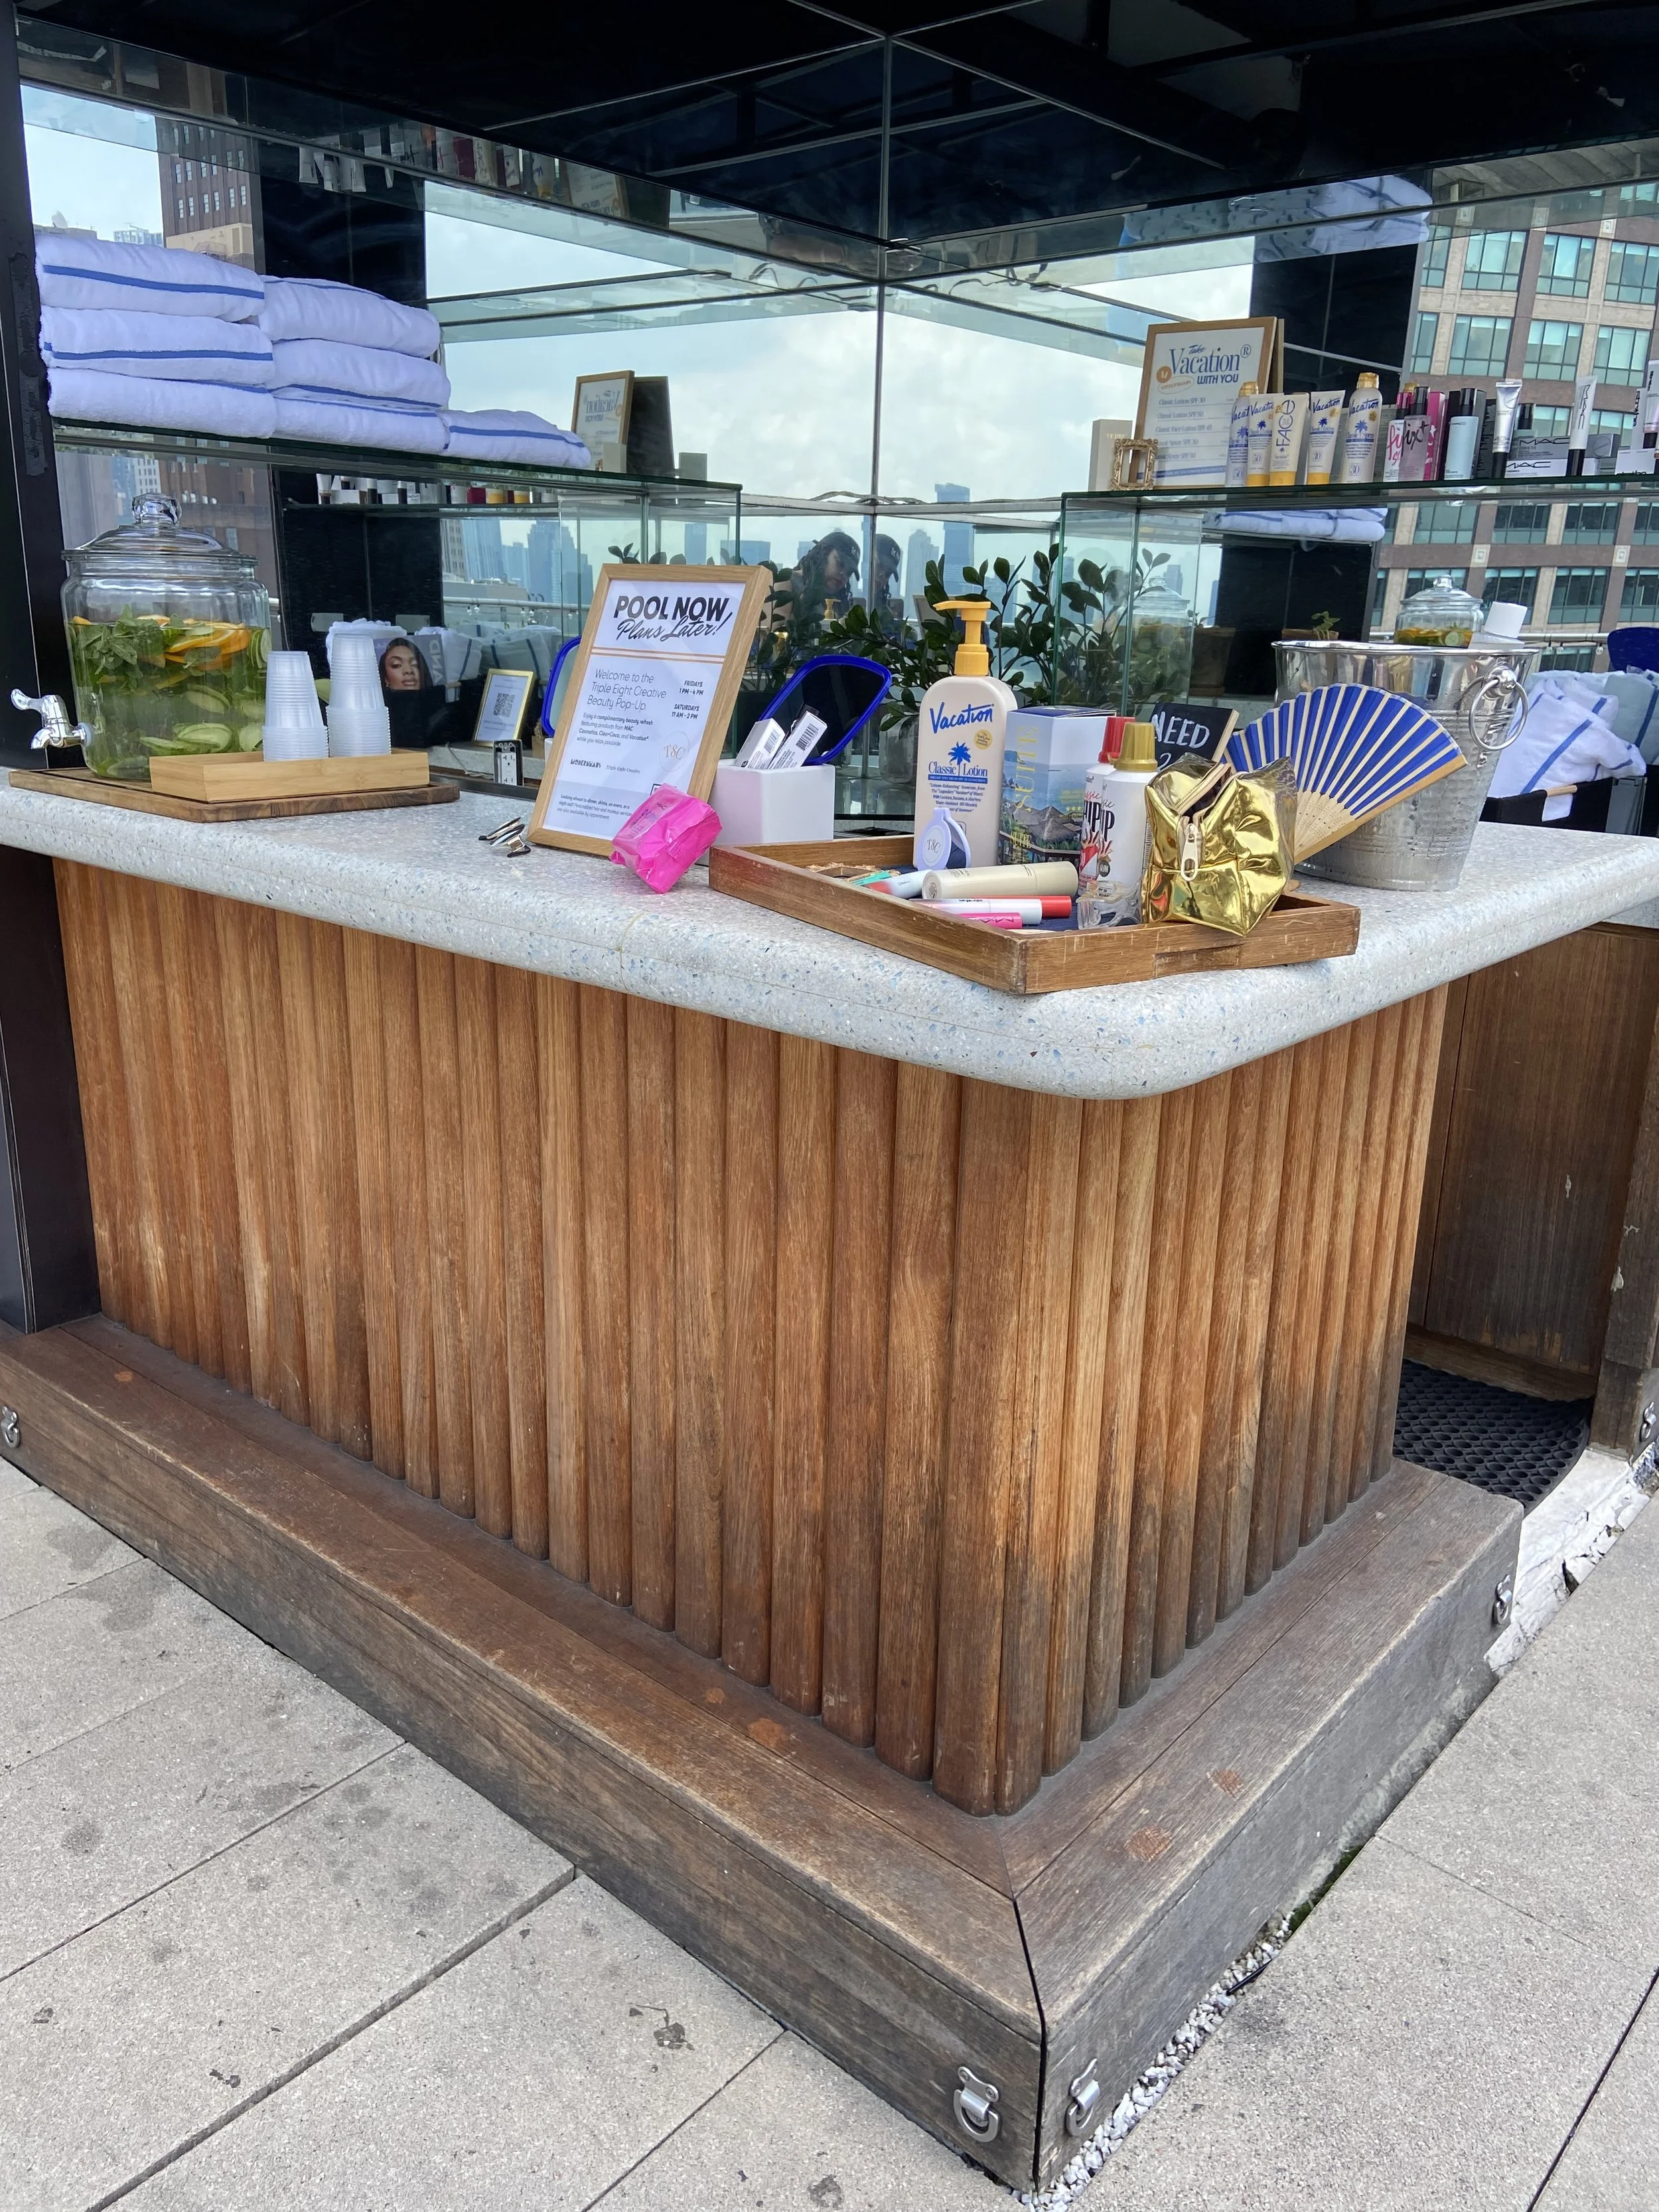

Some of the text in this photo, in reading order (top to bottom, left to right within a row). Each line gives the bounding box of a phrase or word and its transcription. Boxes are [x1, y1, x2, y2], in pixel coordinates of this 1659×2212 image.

[1189, 344, 1206, 355] Take
[1197, 374, 1239, 384] WITH YOU
[1350, 465, 1360, 474] 30
[613, 595, 730, 622] POOL NOW
[616, 611, 733, 642] Plans Later!
[595, 669, 654, 684] Welcome to the
[592, 682, 667, 699] Triple Eight Creative
[587, 695, 646, 712] Beauty Pop-Up
[597, 715, 625, 723] complimentary
[1151, 711, 1210, 749] NEED
[928, 761, 988, 776] Classic Lotion
